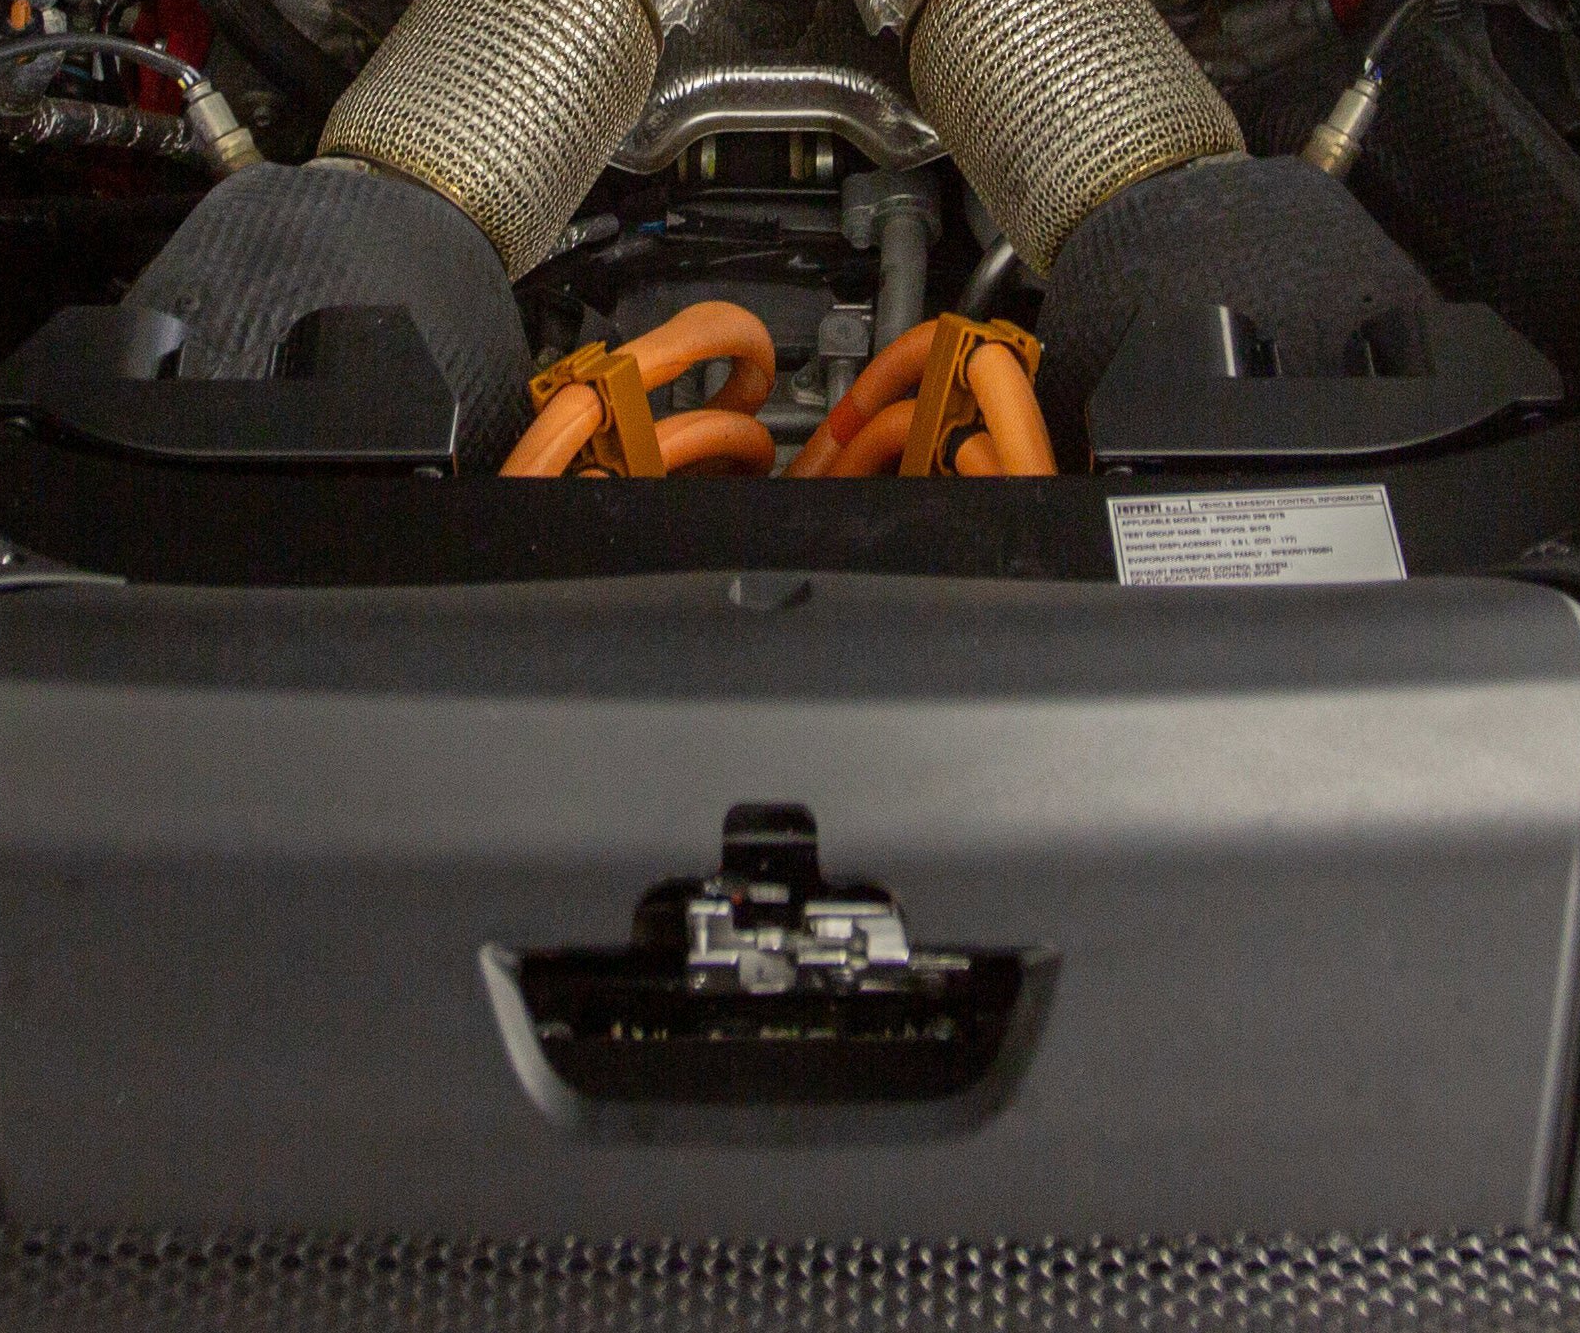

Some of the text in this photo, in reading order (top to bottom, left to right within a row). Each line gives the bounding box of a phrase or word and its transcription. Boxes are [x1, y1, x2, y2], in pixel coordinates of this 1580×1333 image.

[1198, 495, 1374, 510] VEHICLE EMISSION CONTROL INFORMATION
[1117, 504, 1161, 515] Ferrari
[1122, 518, 1170, 526] APPLICABLE
[1216, 514, 1251, 522] FERRARI
[1124, 531, 1144, 539] TEST
[1146, 530, 1175, 538] GROUP
[1178, 528, 1201, 536] NAME
[1126, 543, 1156, 551] ENGINE
[1159, 540, 1222, 550] DISPLACEMENT
[1170, 566, 1211, 574] EMISSION
[1212, 564, 1251, 572] CONTROL
[1254, 561, 1288, 569] SYSTEM
